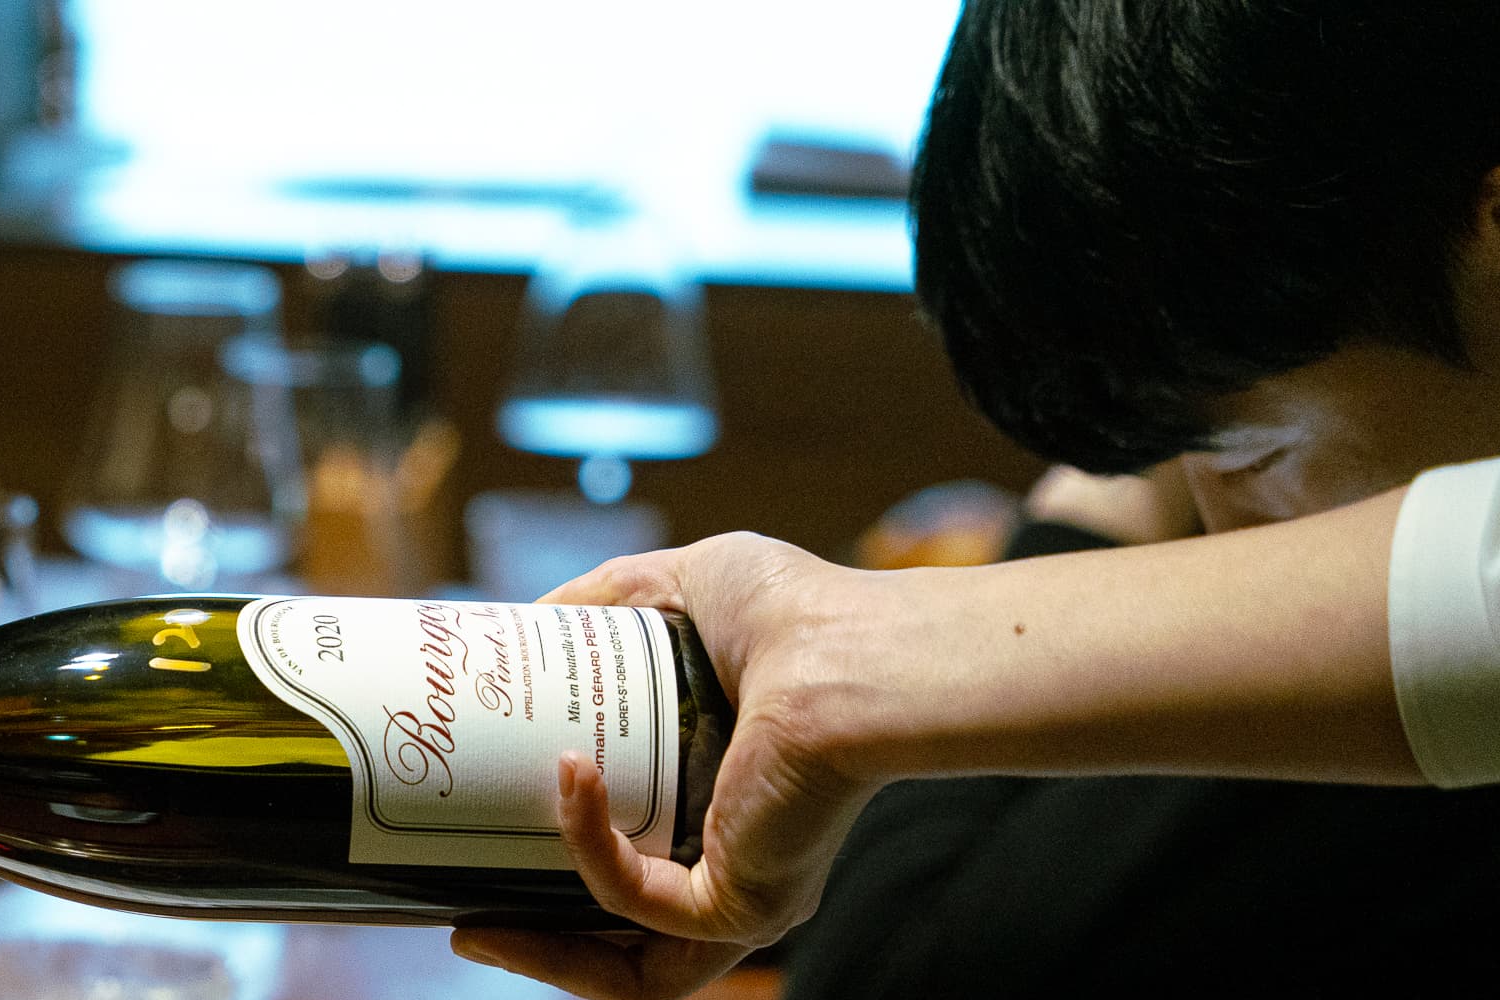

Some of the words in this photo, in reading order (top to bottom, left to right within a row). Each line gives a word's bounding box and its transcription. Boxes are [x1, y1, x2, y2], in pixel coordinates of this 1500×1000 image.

[270, 605, 294, 644] BOURGOGN
[312, 614, 344, 662] 2020
[575, 606, 598, 647] PEIRAZE
[277, 648, 288, 658] DE
[287, 660, 303, 676] VIN
[476, 632, 513, 718] Pinot
[561, 638, 579, 682] bouteille
[383, 601, 469, 798] Bourgog
[523, 664, 534, 723] APPELLATION
[570, 683, 580, 698] en
[591, 650, 604, 706] GÉRARD
[614, 653, 629, 737] MOREY-ST-DENIS
[567, 700, 581, 724] Mis
[593, 711, 605, 775] omaine
